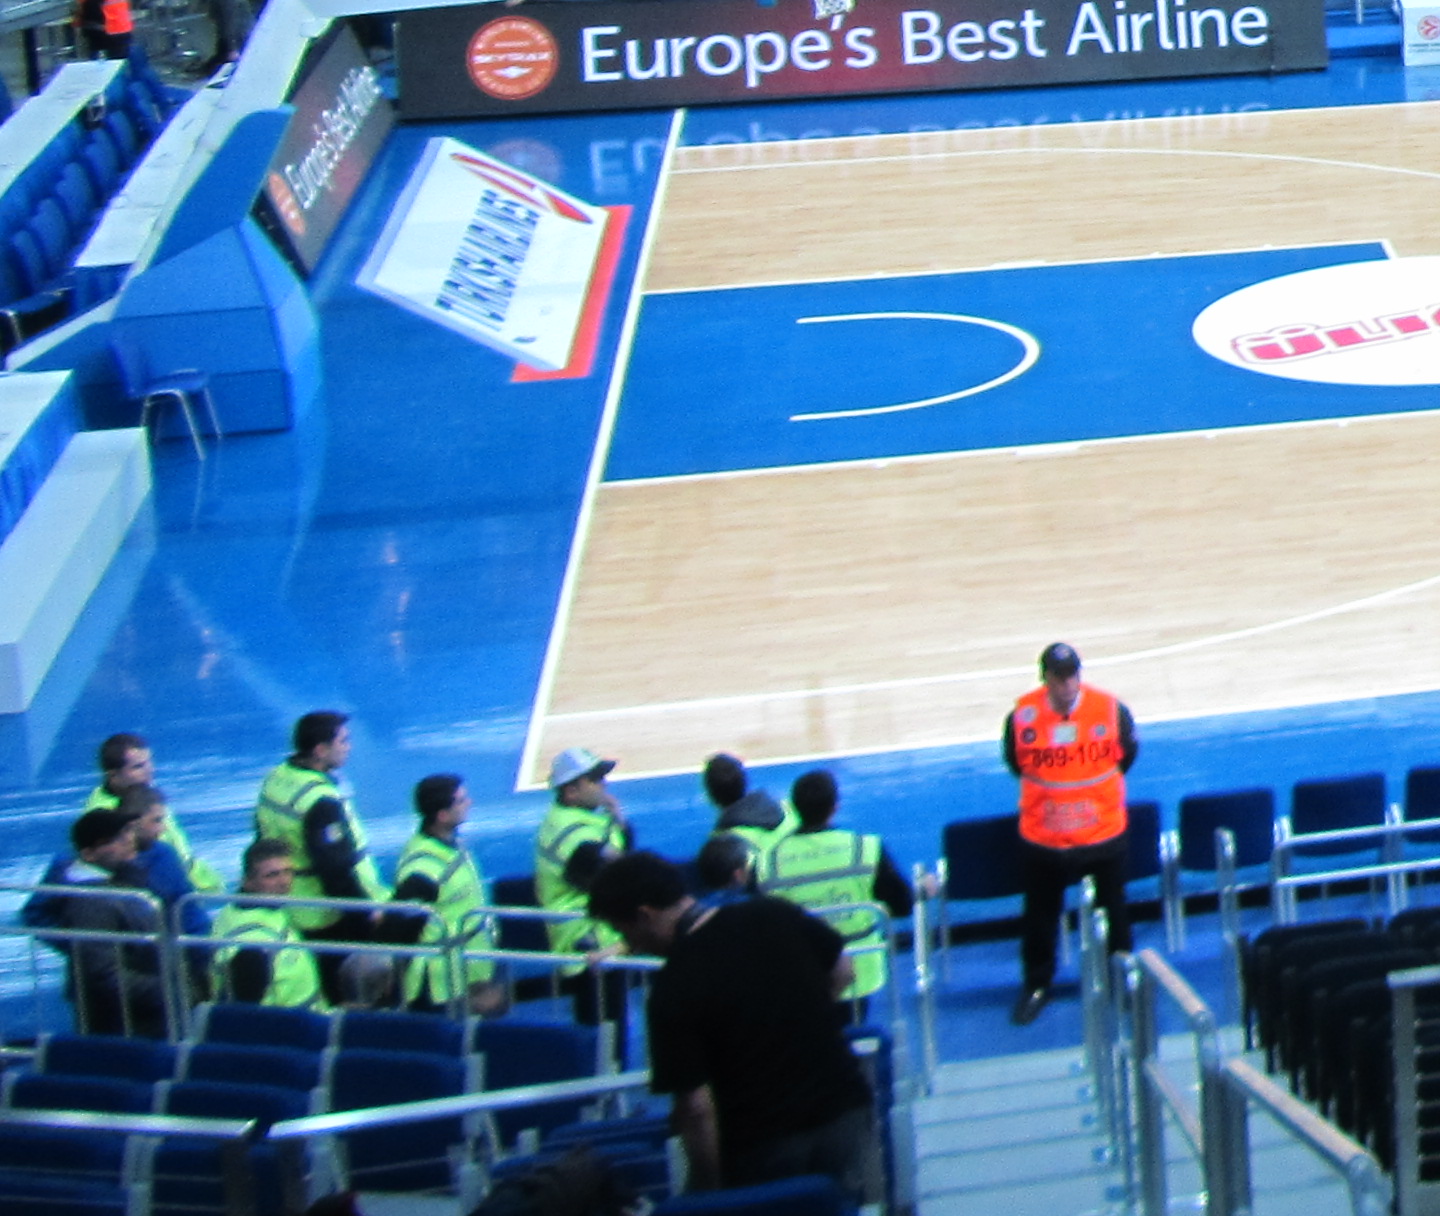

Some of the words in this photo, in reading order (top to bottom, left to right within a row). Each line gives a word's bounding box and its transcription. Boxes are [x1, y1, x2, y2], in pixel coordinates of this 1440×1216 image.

[581, 13, 879, 89] Europe's
[901, 8, 1048, 66] Best
[459, 187, 541, 269] AIRLINES
[433, 247, 519, 333] TURKISH
